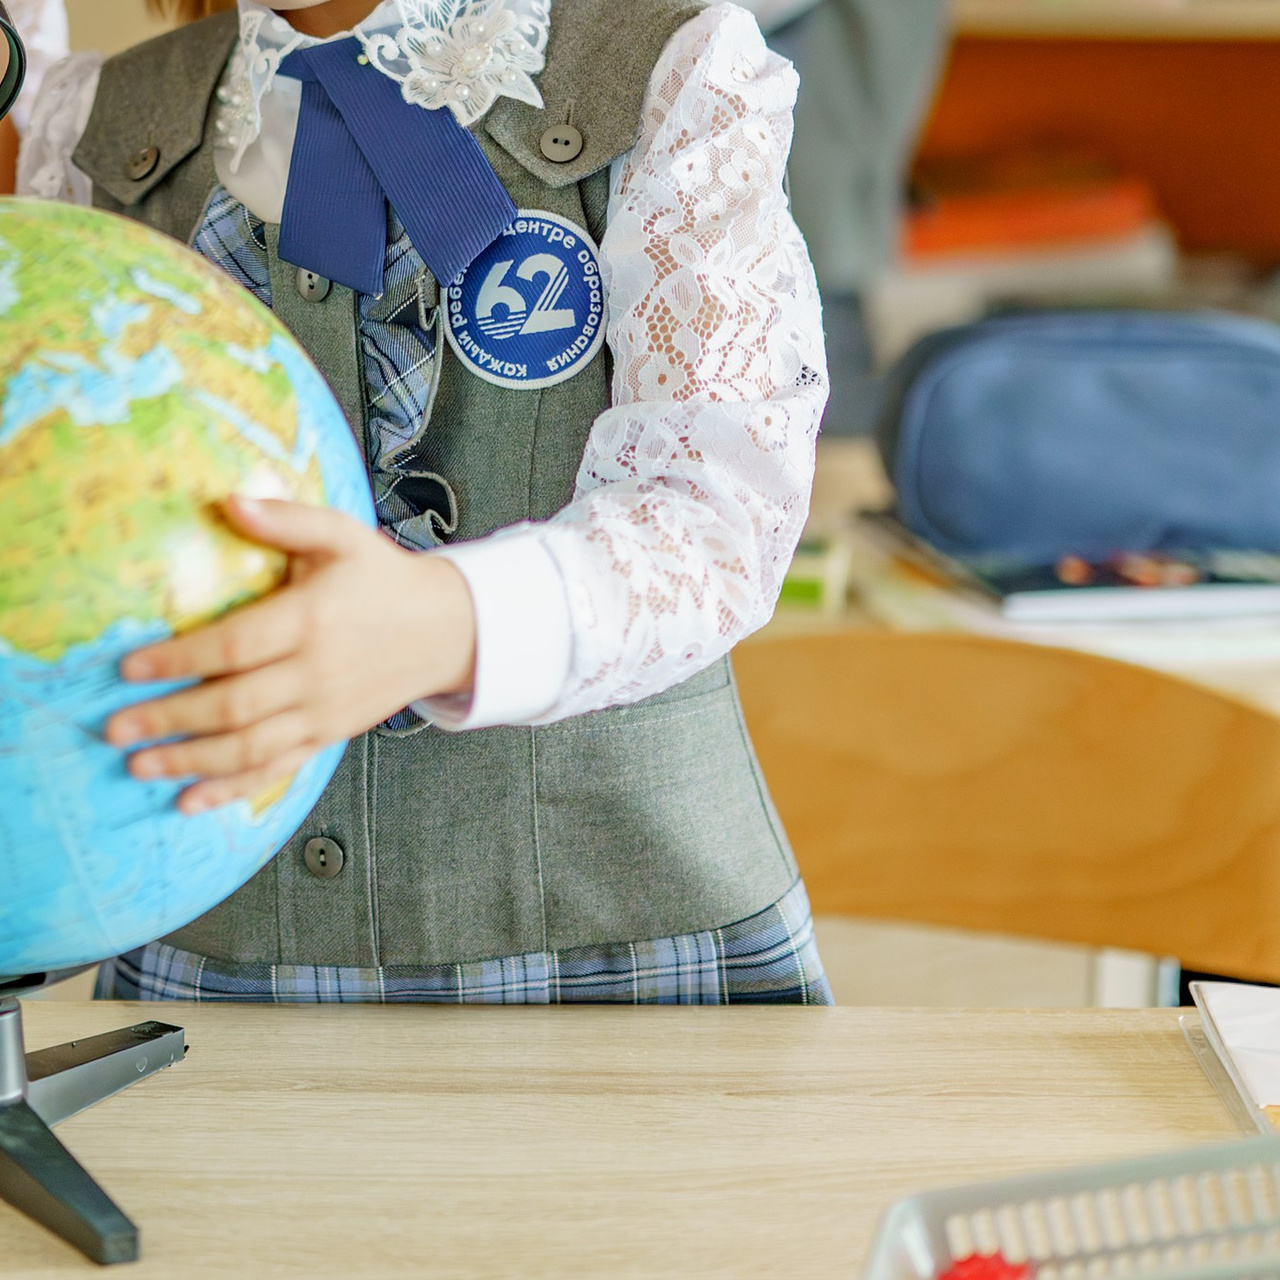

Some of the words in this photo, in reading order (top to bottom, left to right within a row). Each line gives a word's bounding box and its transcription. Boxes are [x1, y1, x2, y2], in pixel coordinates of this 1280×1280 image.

[449, 267, 468, 328] ребе
[475, 253, 576, 339] 62
[546, 250, 602, 372] образования
[458, 330, 527, 377] каждый
